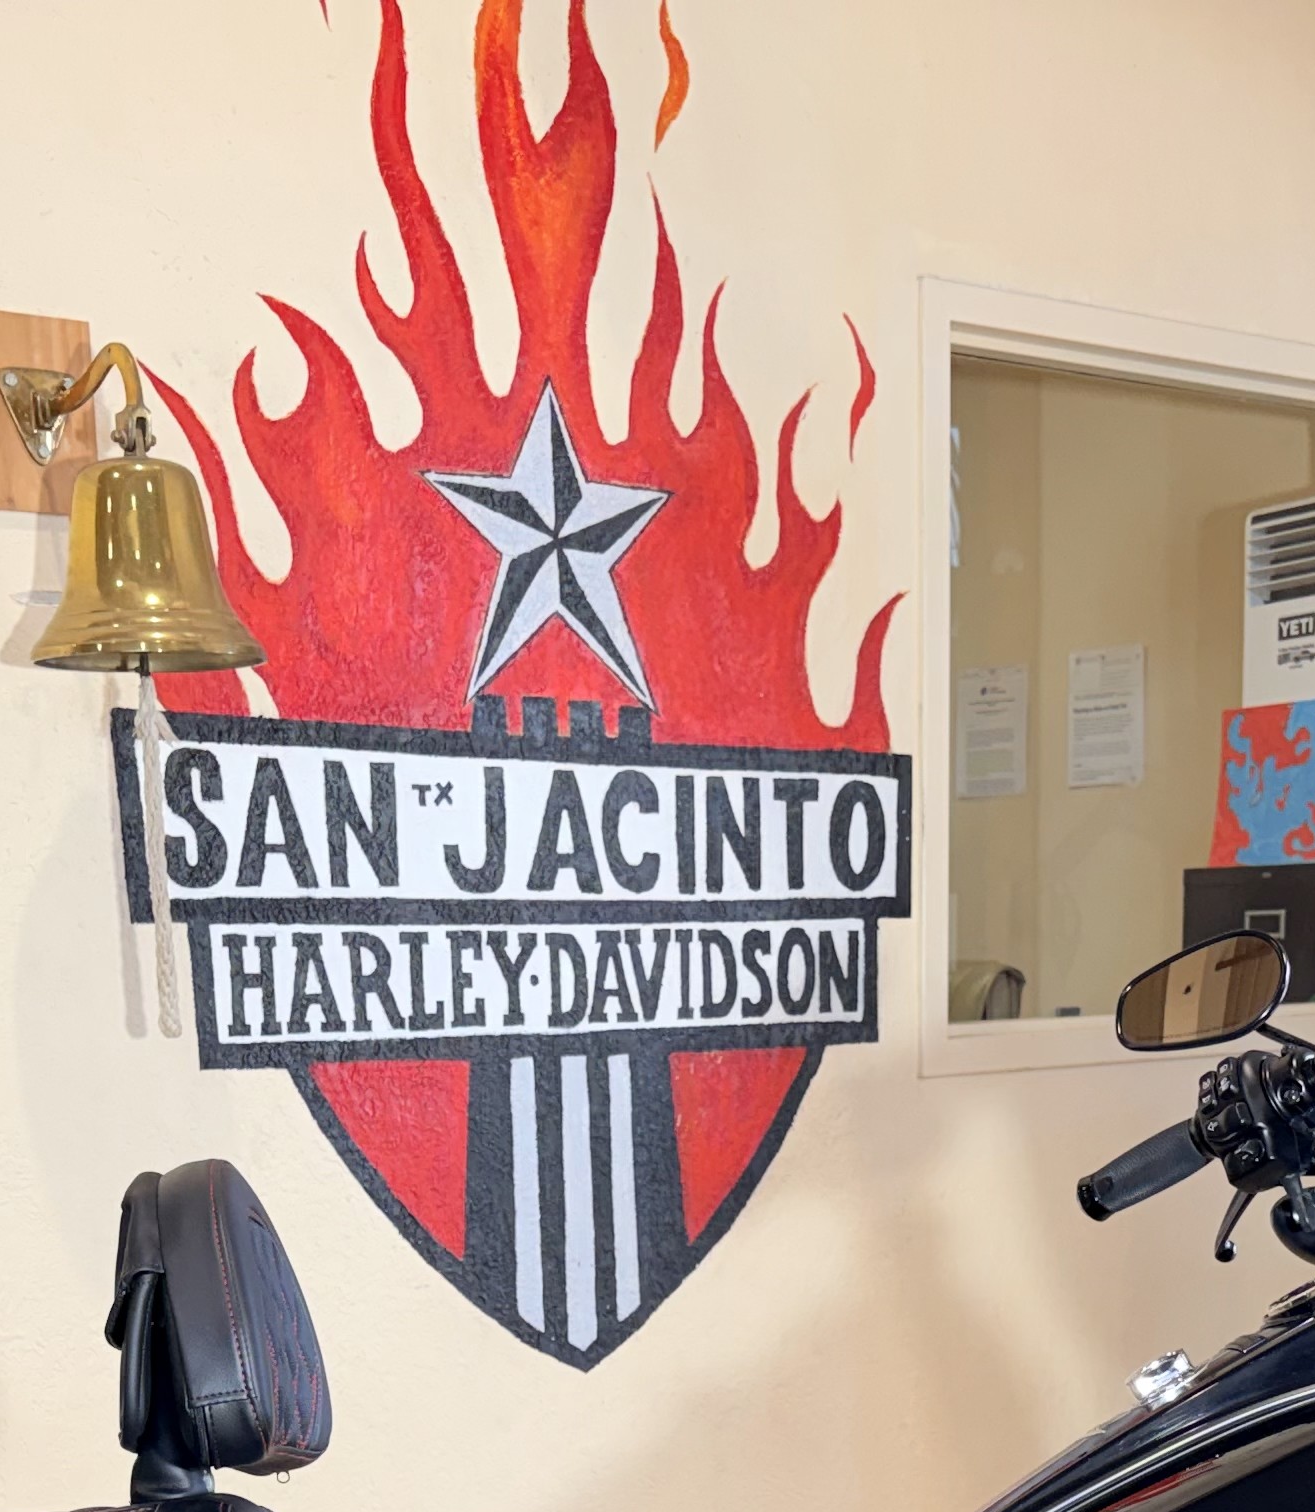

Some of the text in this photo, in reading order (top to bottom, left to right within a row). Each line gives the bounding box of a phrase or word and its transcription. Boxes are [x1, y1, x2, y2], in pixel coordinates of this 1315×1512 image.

[1279, 616, 1314, 637] YETI
[164, 747, 888, 895] SAN TX JACINTO
